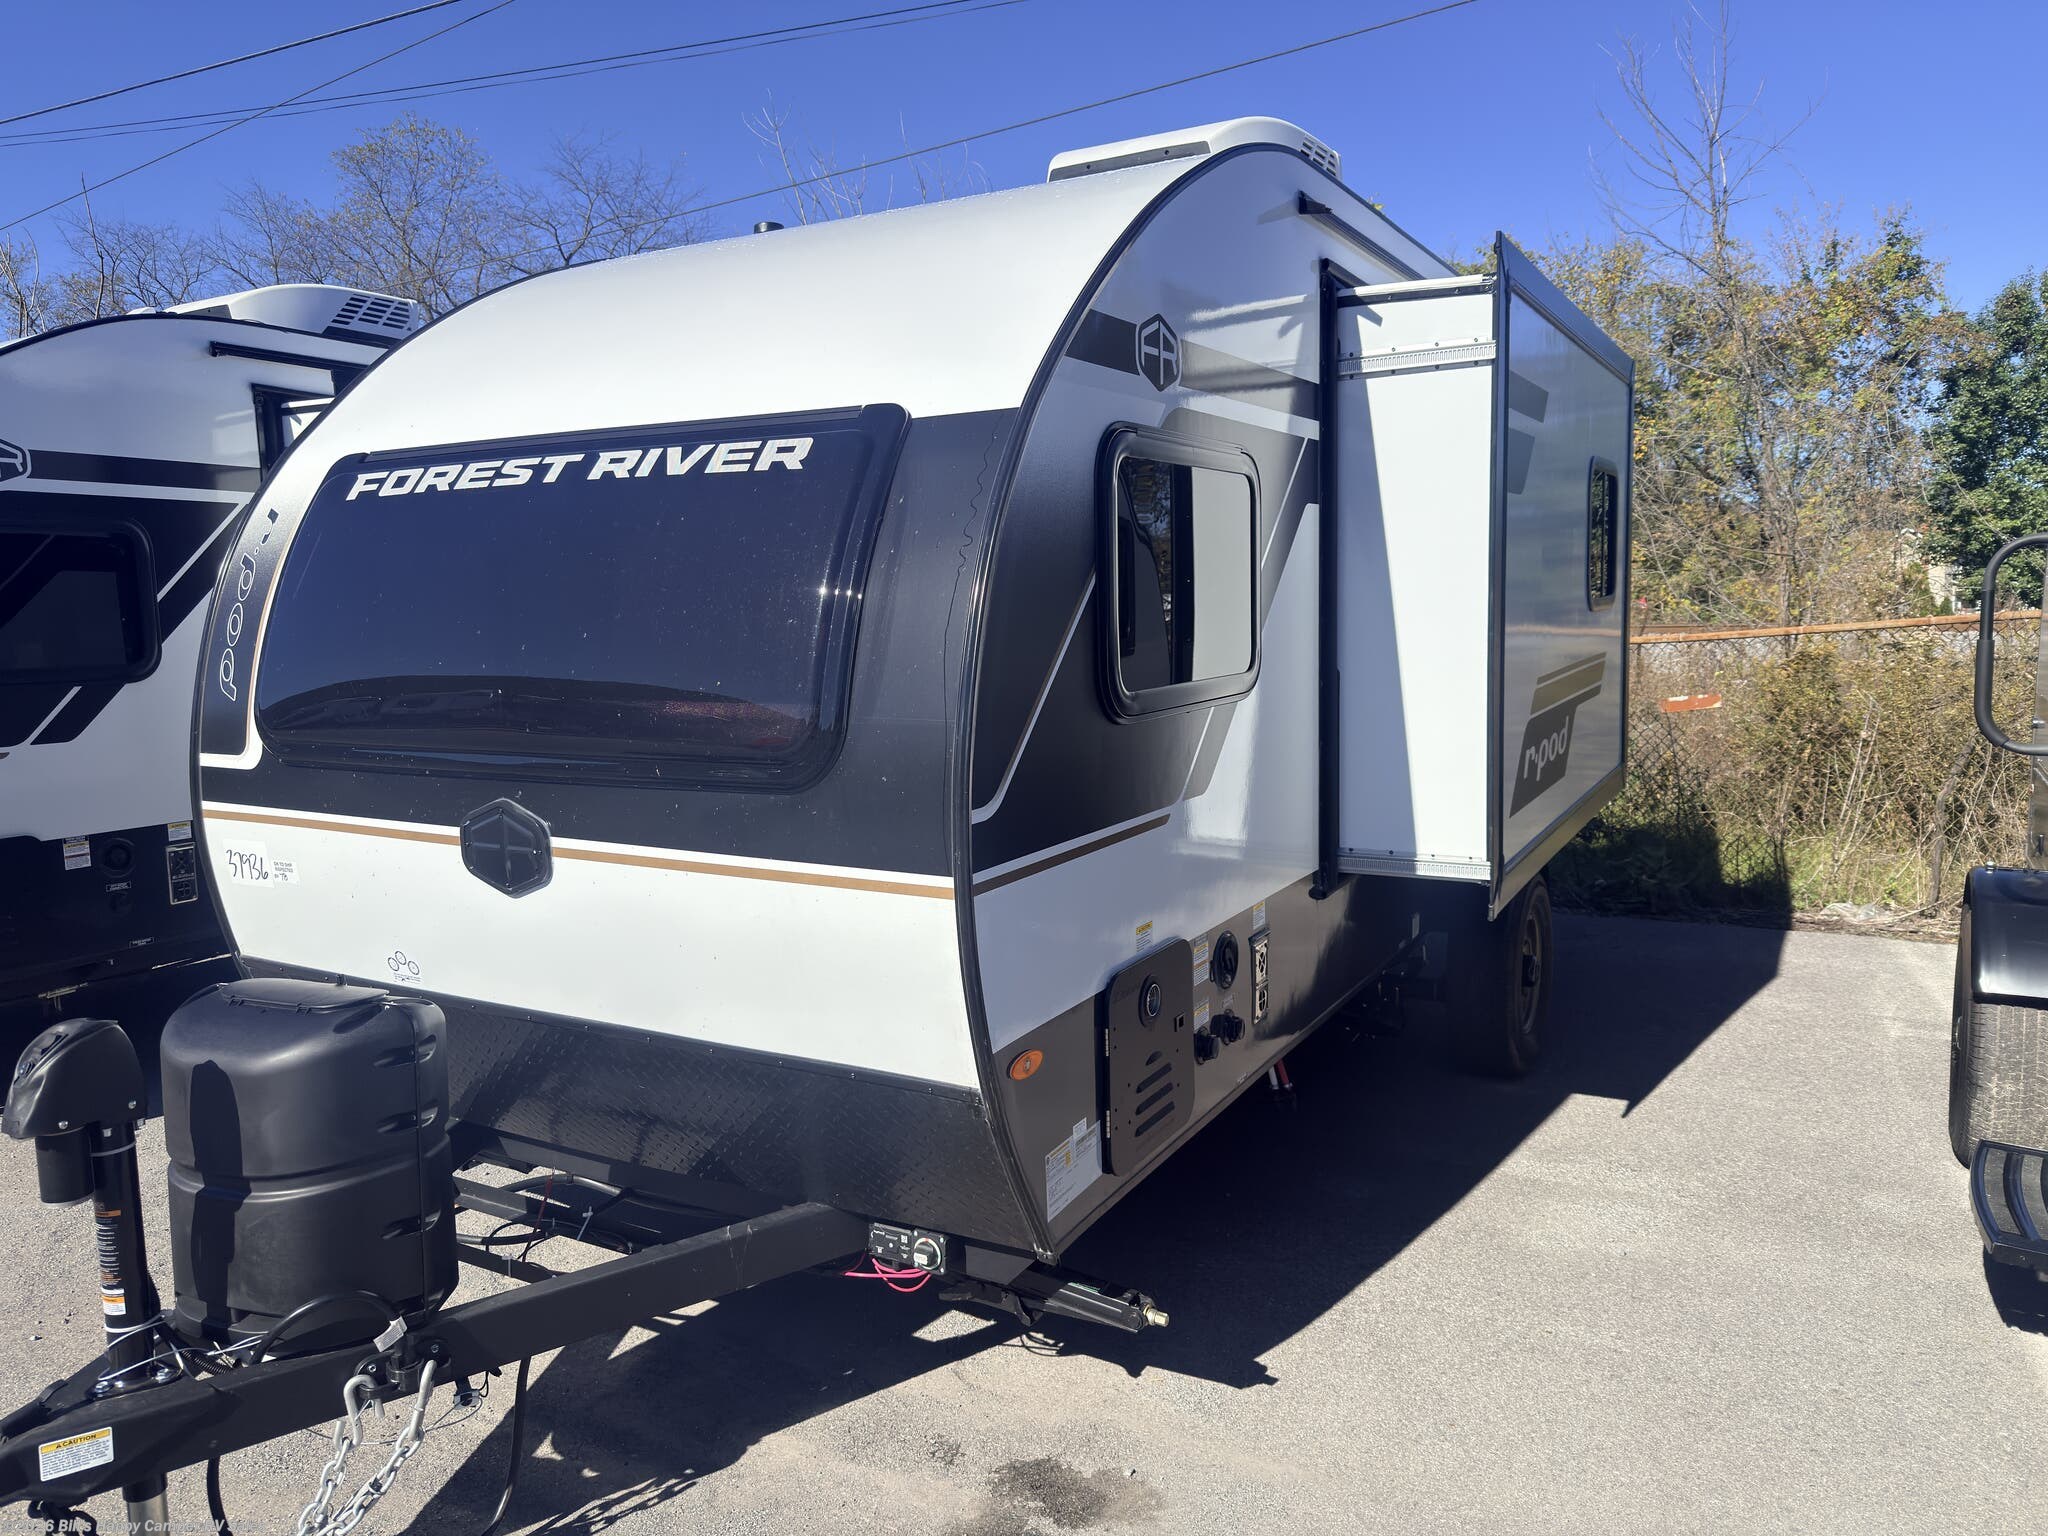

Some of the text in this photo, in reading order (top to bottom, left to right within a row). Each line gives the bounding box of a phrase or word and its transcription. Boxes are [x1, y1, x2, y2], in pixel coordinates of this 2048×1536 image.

[346, 437, 815, 502] FOREST RIVER
[226, 849, 269, 880] 37936
[62, 1433, 97, 1447] CAUTION
